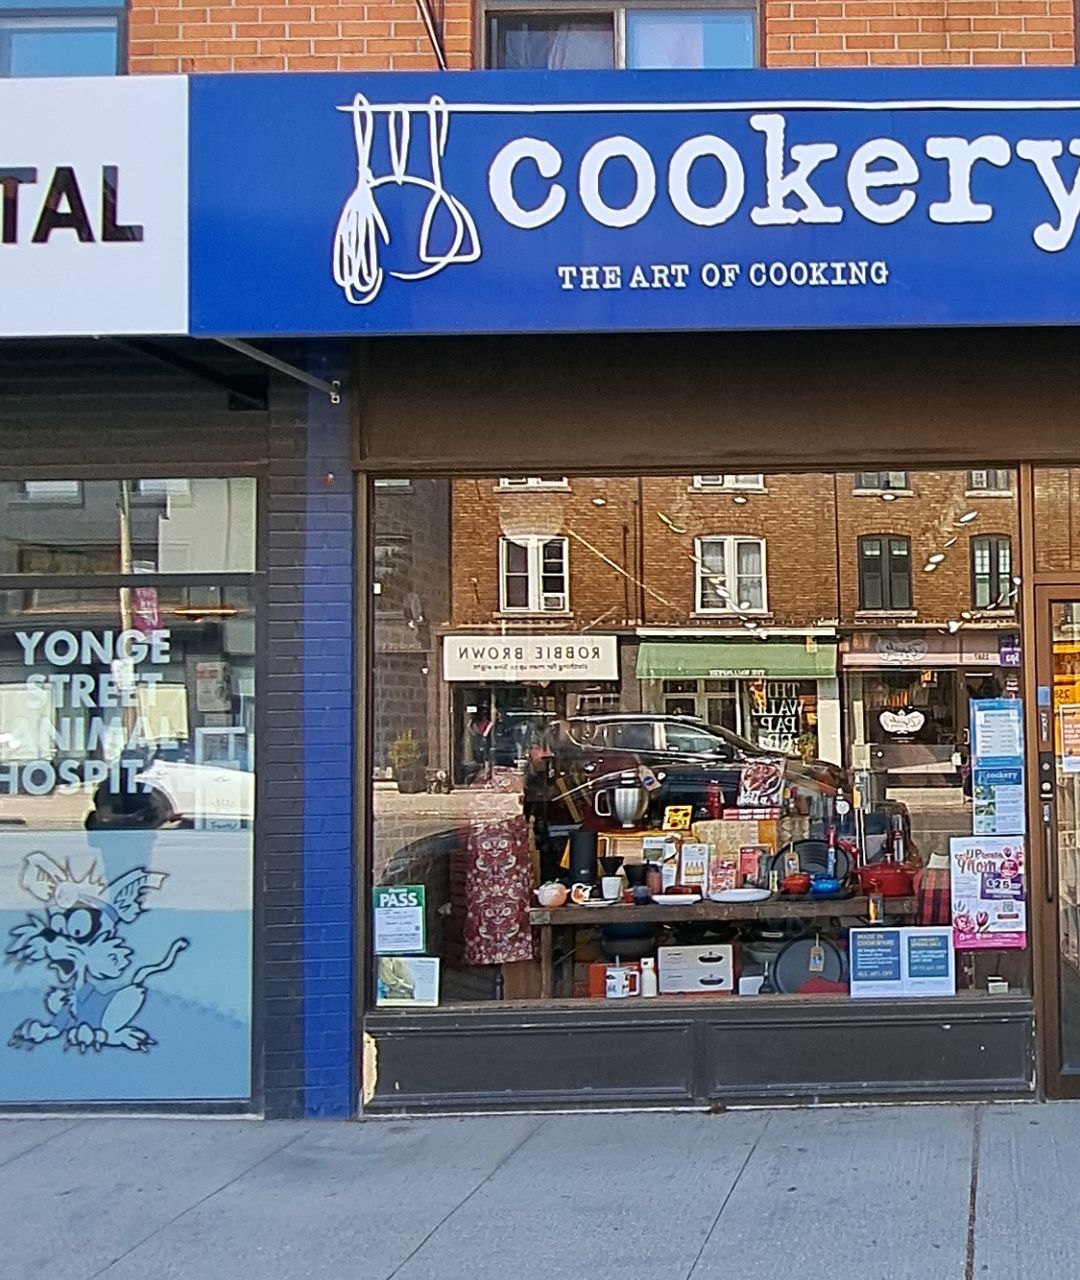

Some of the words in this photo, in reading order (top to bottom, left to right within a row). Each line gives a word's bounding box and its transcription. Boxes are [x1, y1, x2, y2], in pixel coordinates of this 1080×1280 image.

[557, 266, 622, 290] THE
[628, 264, 690, 289] ART
[701, 263, 741, 288] OF
[749, 261, 889, 287] COOKING
[15, 629, 171, 666] YONGE
[25, 673, 164, 708] STREET
[380, 892, 418, 908] PASS
